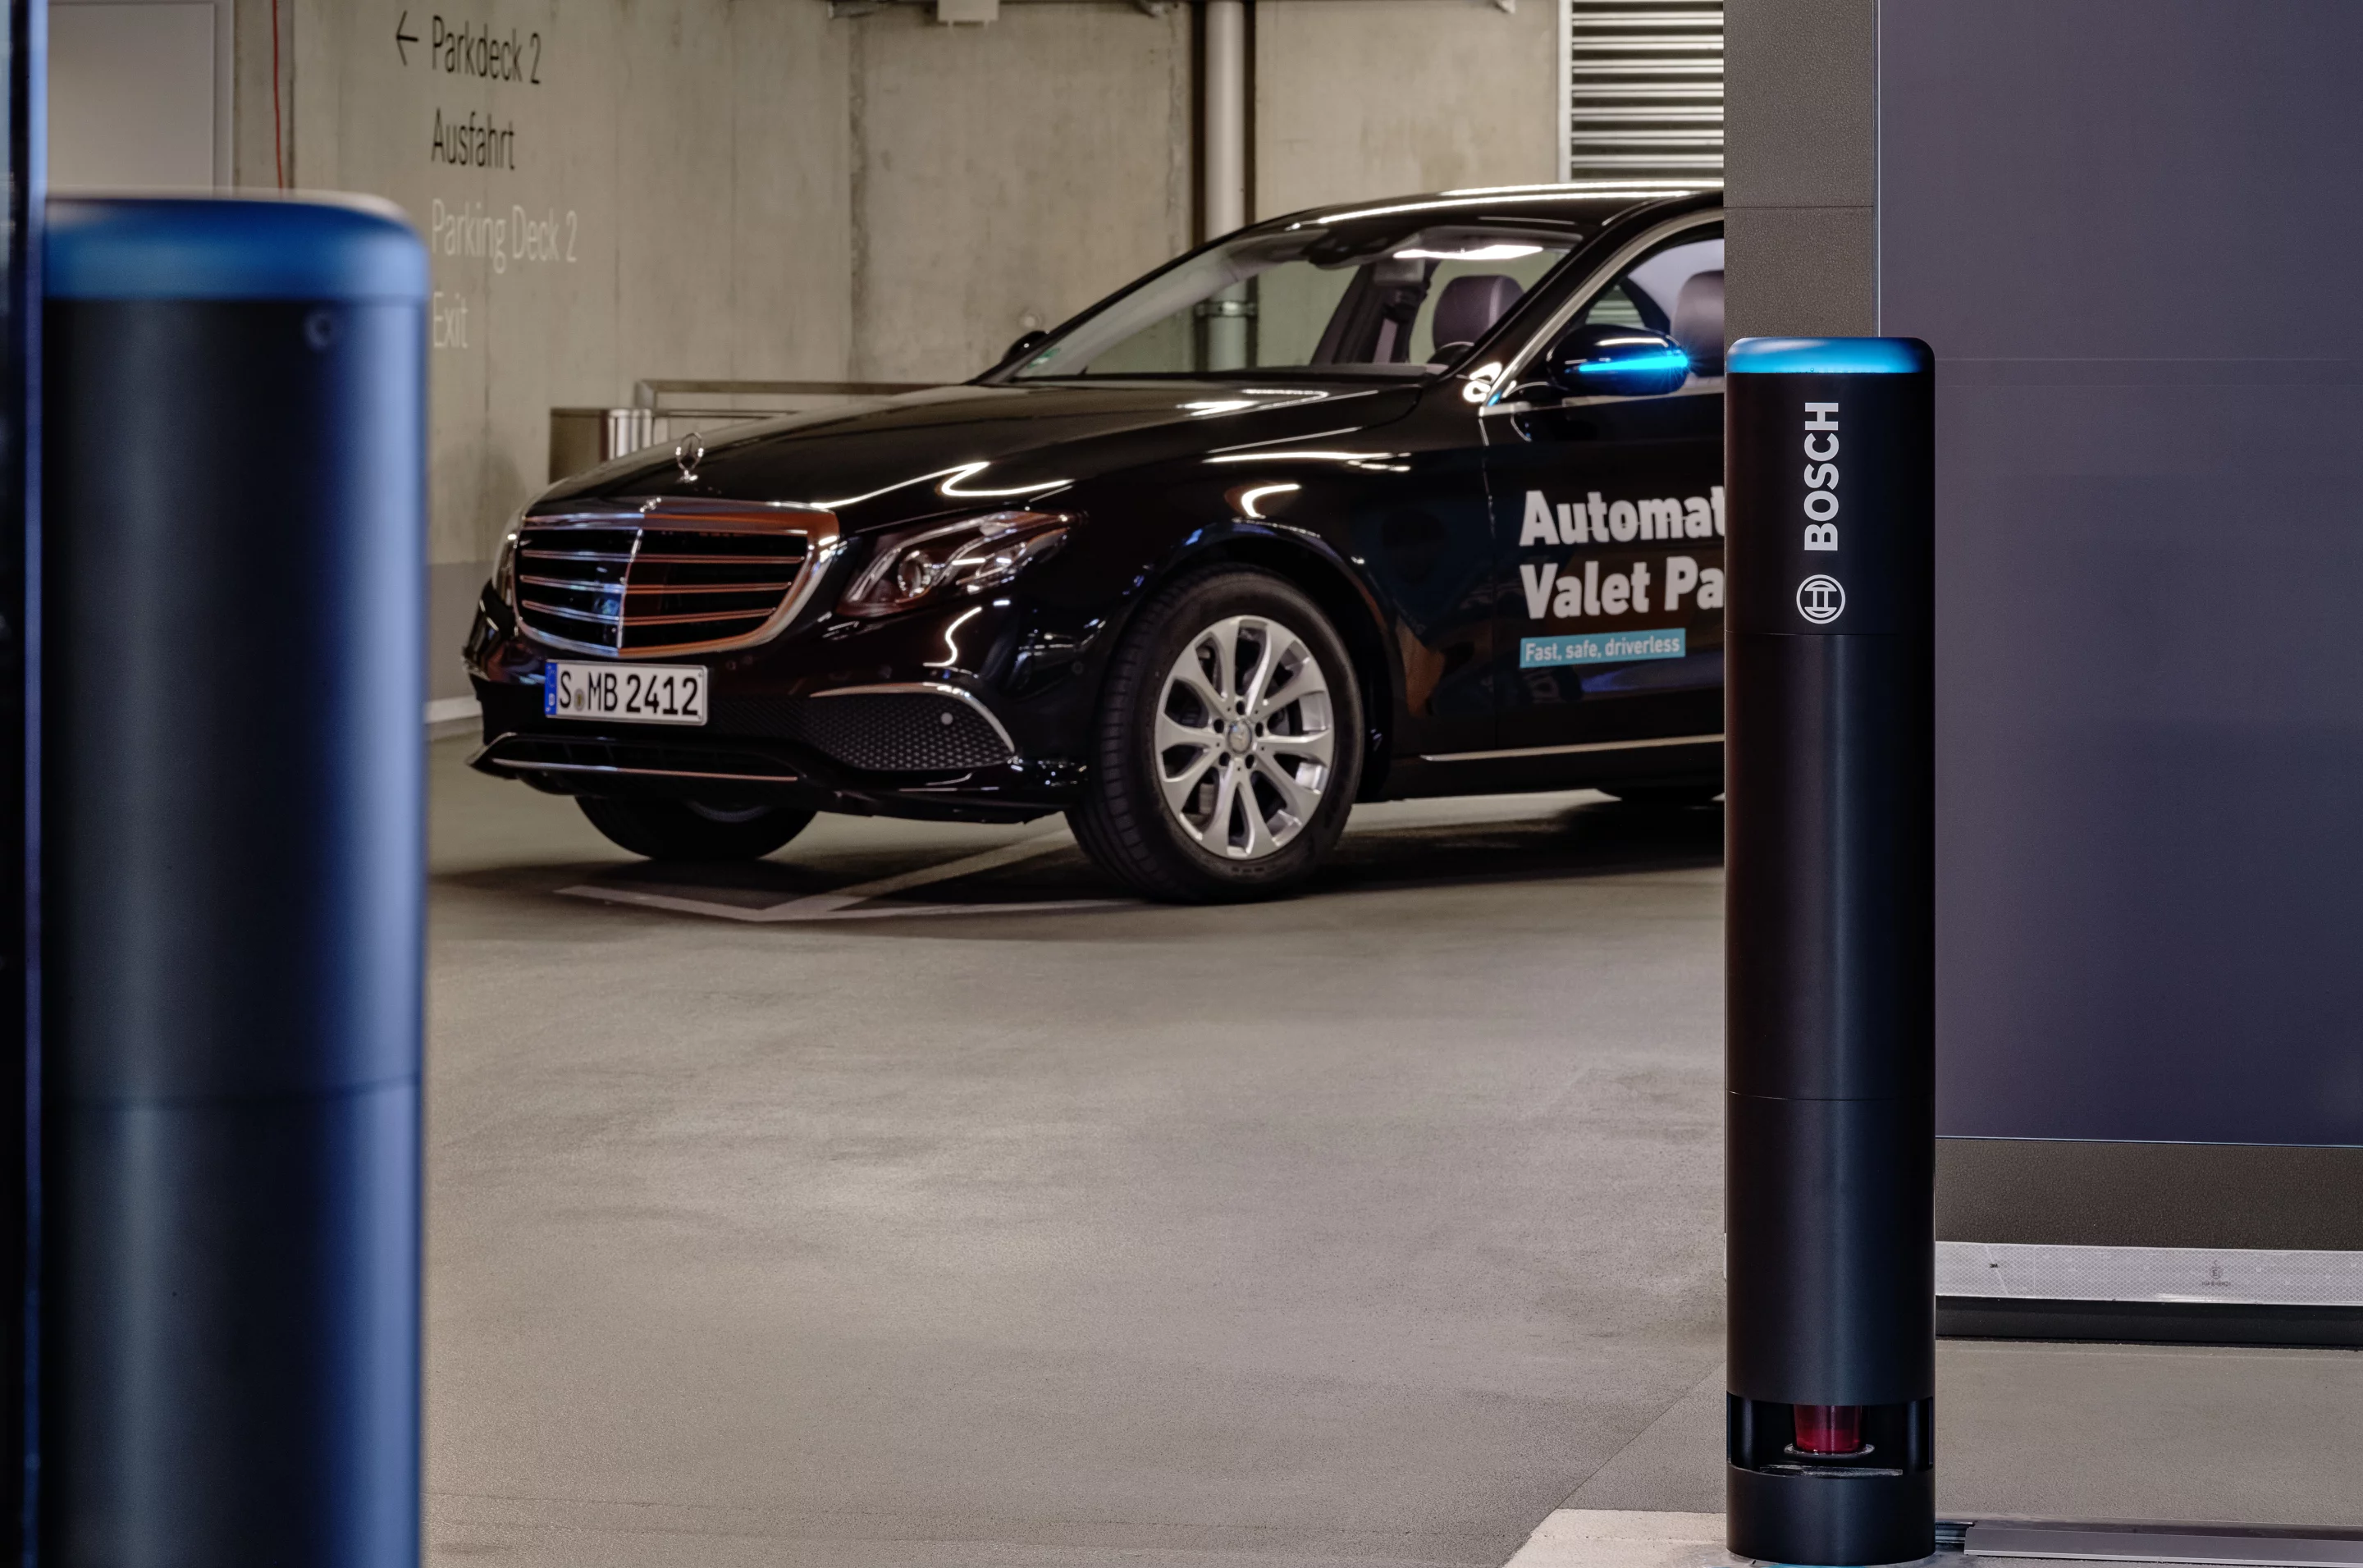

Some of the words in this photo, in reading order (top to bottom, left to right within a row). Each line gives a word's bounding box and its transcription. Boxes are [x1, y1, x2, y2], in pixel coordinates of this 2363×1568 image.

[432, 14, 523, 83] Parkdeck
[529, 32, 542, 85] 2
[431, 107, 515, 171] Ausfahrt
[432, 199, 506, 274] Parking
[512, 204, 560, 262] Deck
[565, 210, 578, 263] 2
[432, 291, 468, 350] Exit
[1803, 402, 1840, 551] BOSCH
[1520, 486, 1725, 546] Automat
[1520, 560, 1651, 619] Valet
[1664, 555, 1725, 611] Pa
[1525, 643, 1562, 662] Fast,
[1565, 640, 1602, 659] safe,
[1605, 636, 1680, 656] driverless
[560, 670, 572, 709] S
[588, 671, 618, 711] MB
[626, 674, 698, 715] 2412
